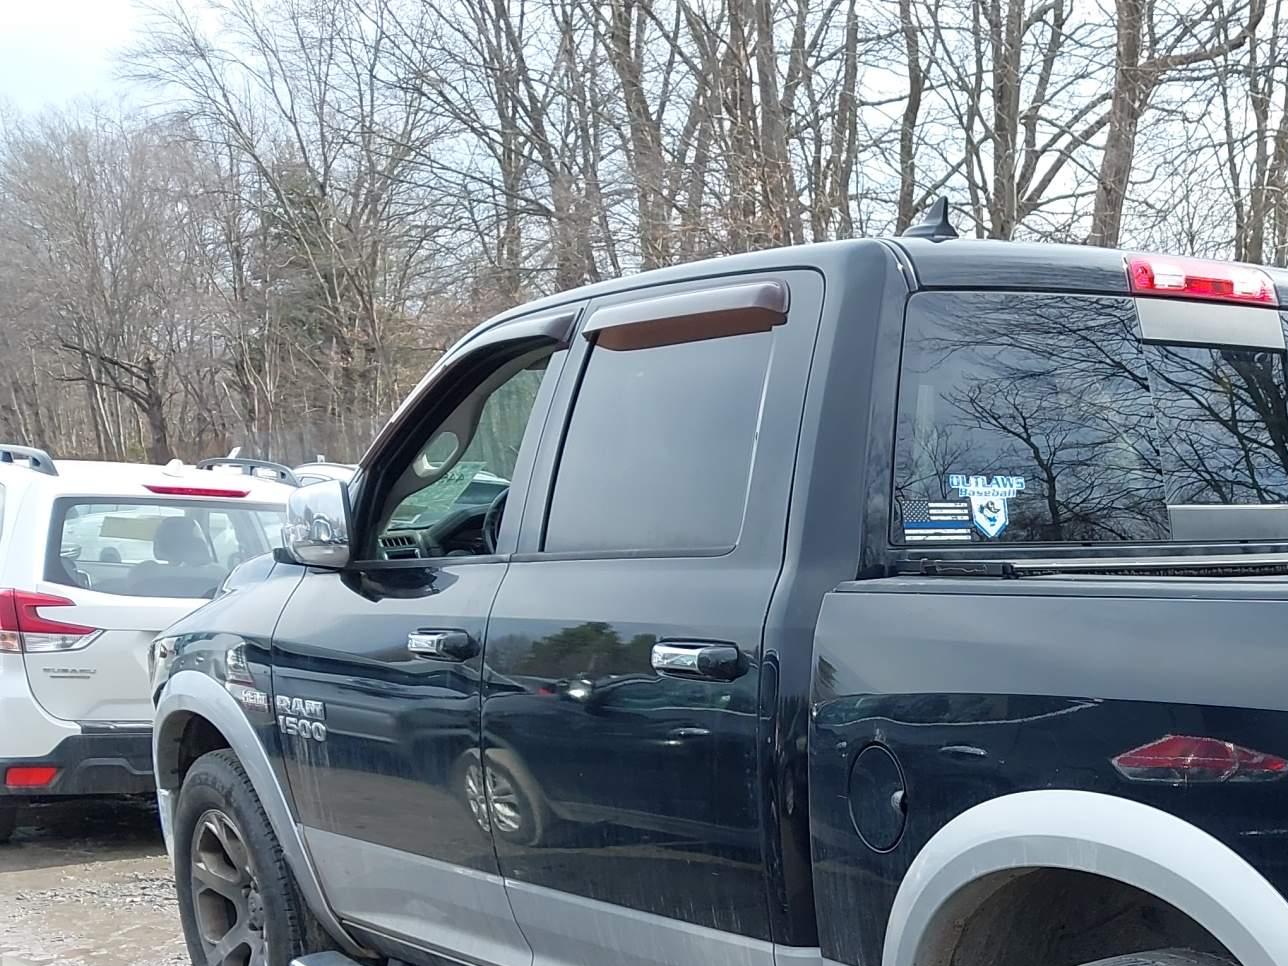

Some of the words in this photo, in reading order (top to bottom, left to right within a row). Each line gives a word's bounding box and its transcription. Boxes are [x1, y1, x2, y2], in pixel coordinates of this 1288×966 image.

[950, 474, 1025, 489] OUTLAWS
[960, 488, 1016, 497] Baseball
[276, 694, 327, 720] RAM
[278, 714, 327, 742] 1500
